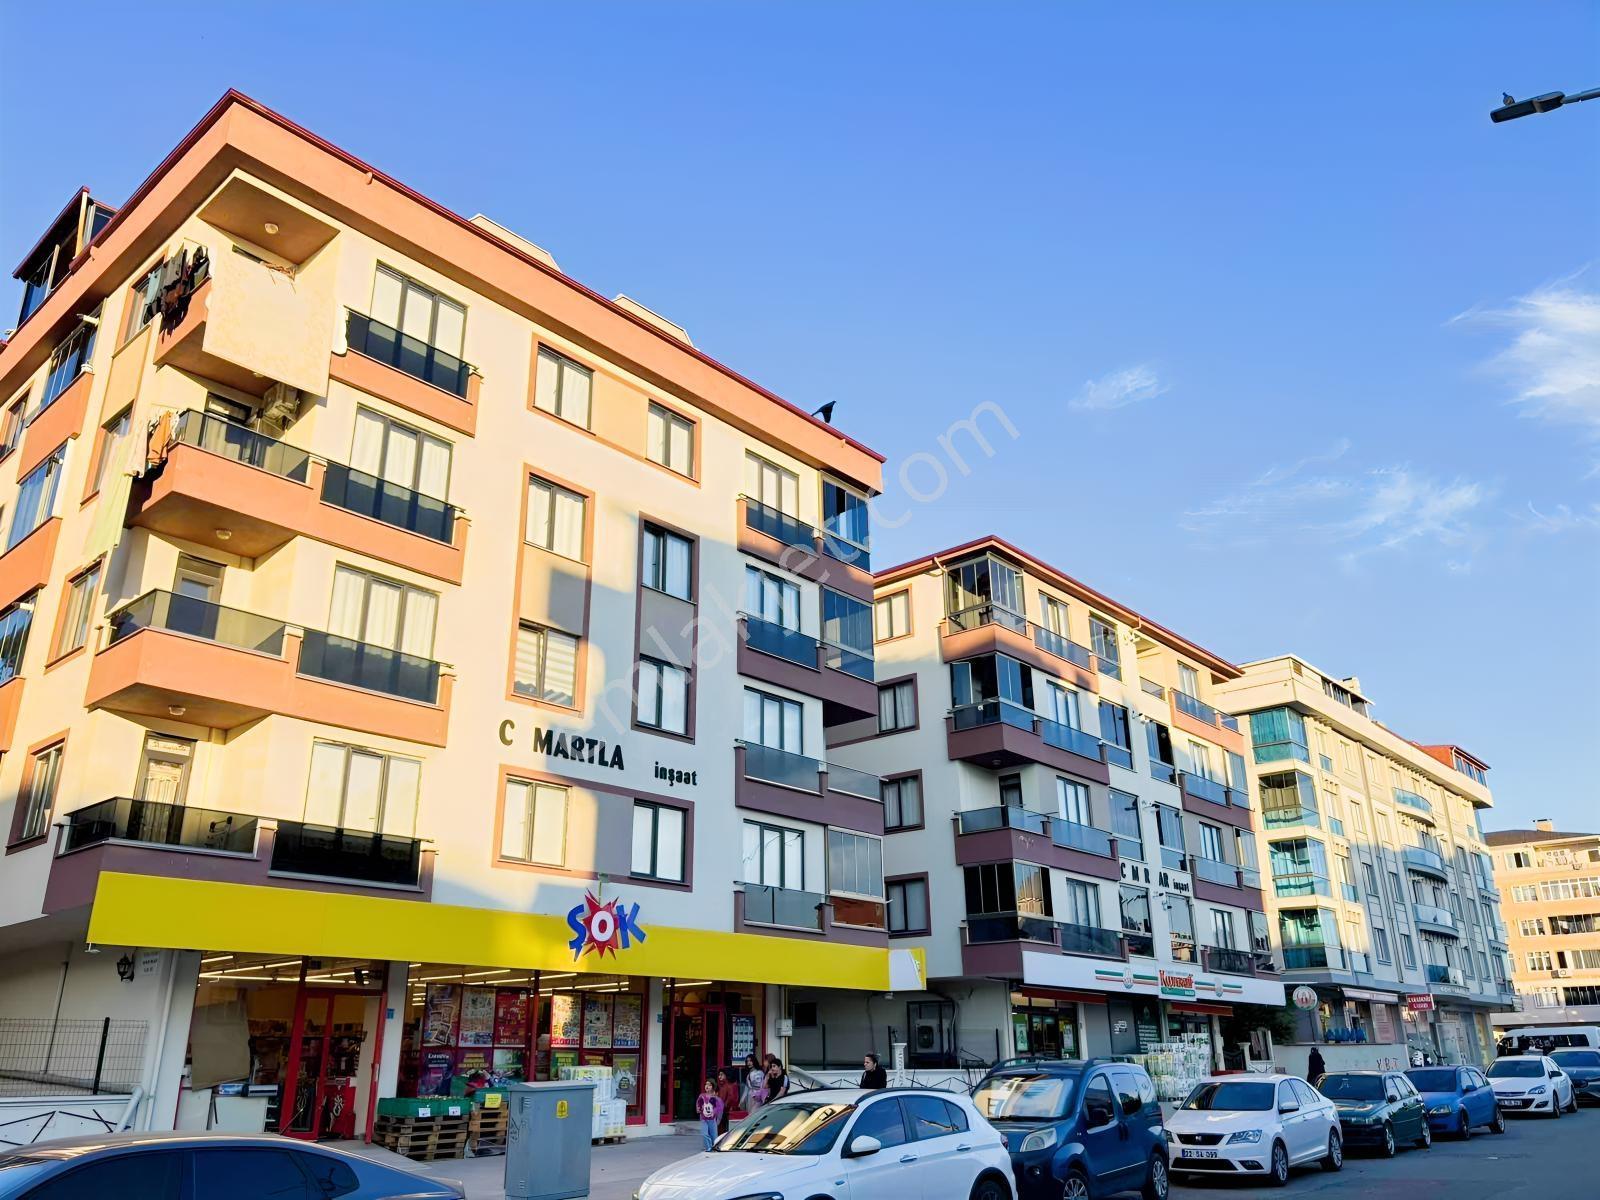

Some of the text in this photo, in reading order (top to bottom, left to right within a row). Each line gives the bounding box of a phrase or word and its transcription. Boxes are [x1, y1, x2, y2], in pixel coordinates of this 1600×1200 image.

[499, 719, 697, 786] C MARTLA inşaat
[567, 901, 647, 963] ŞOK
